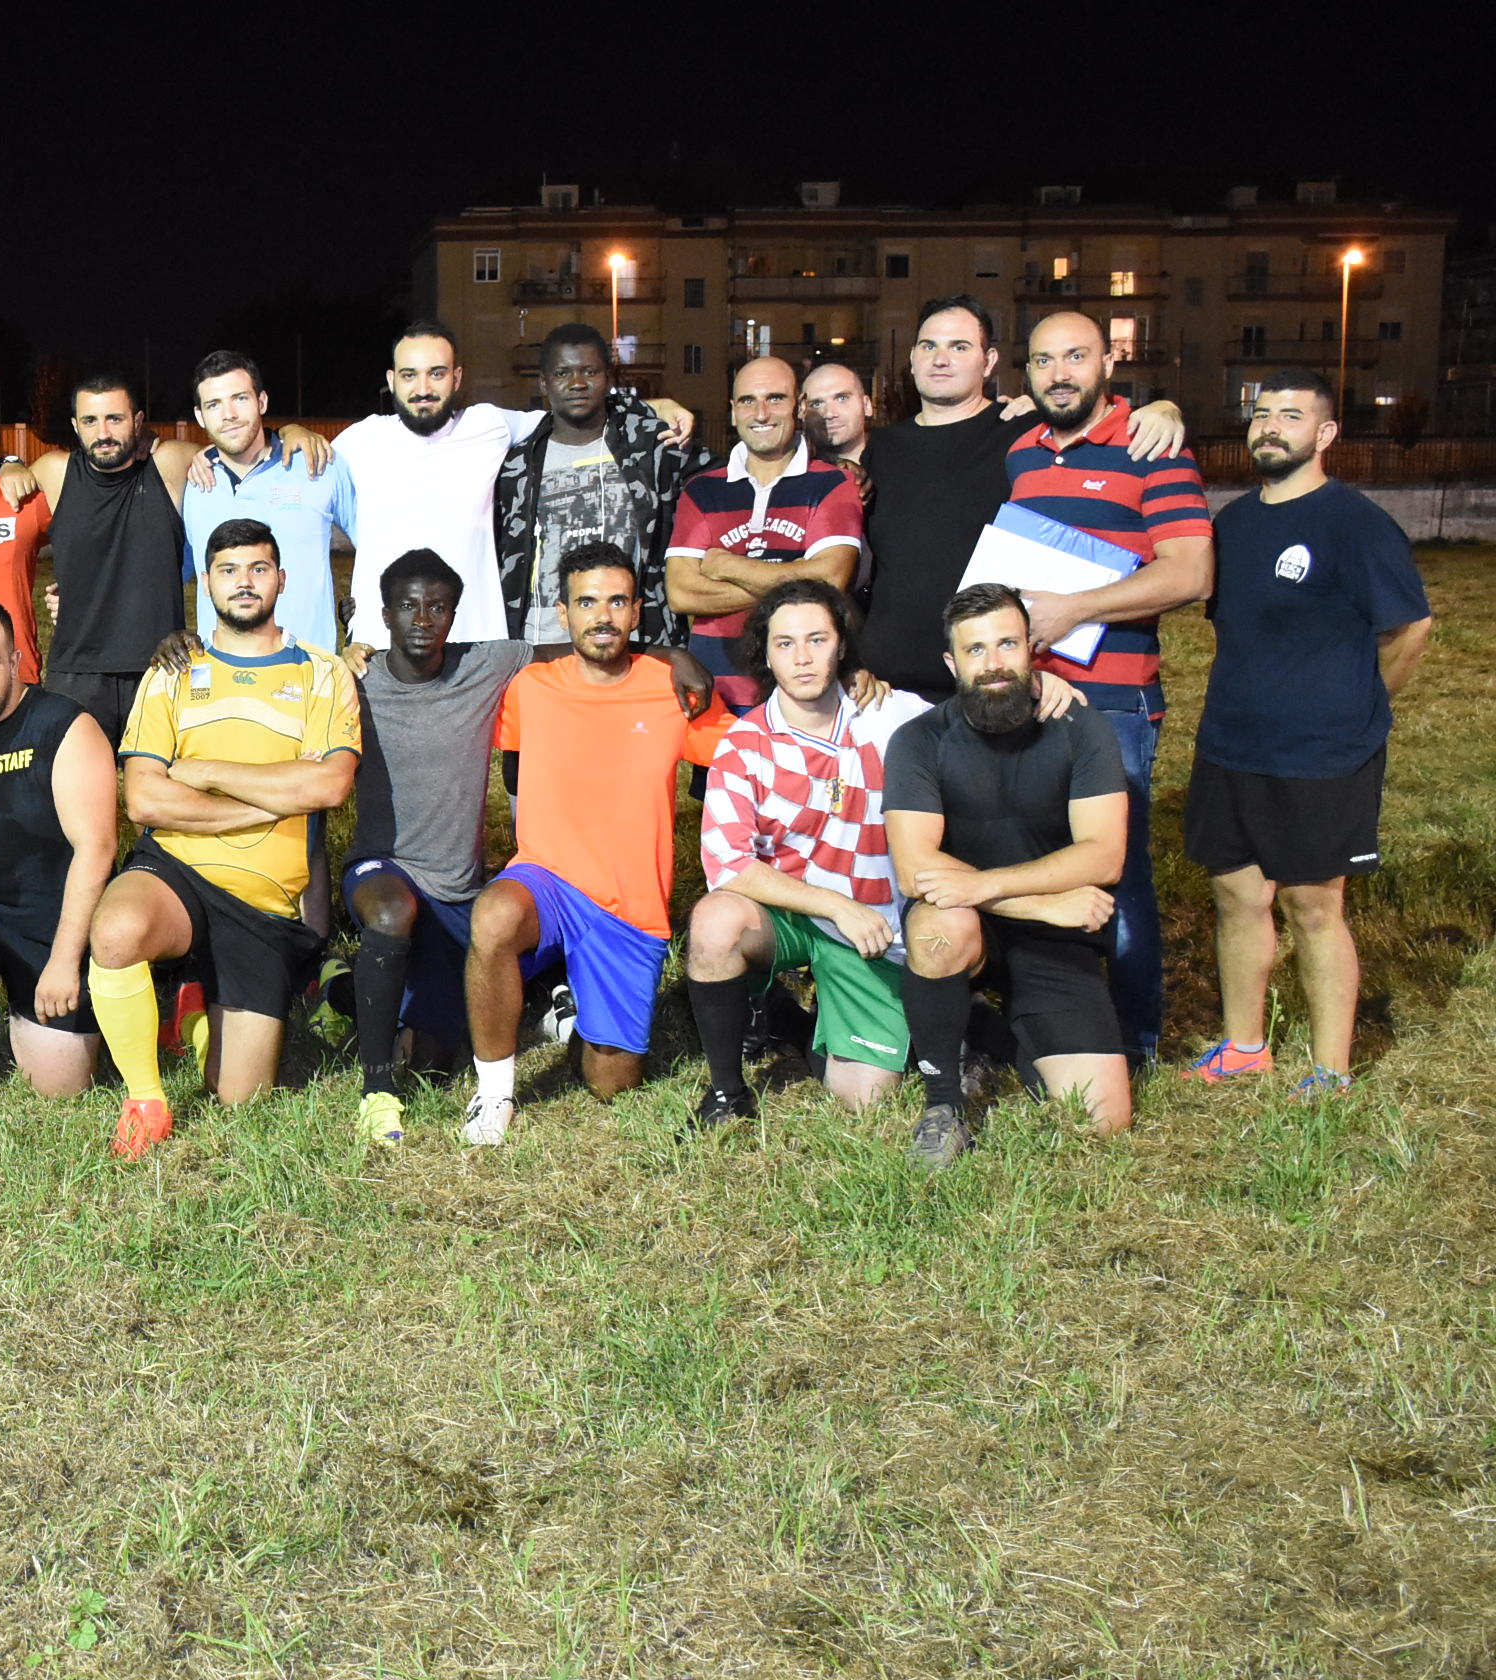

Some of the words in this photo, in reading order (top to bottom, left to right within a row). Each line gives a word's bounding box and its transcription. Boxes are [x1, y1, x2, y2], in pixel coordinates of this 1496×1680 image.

[566, 526, 603, 538] PEOPLE
[719, 522, 751, 549] RUG
[763, 517, 806, 543] EAGUE
[190, 693, 211, 701] 2007
